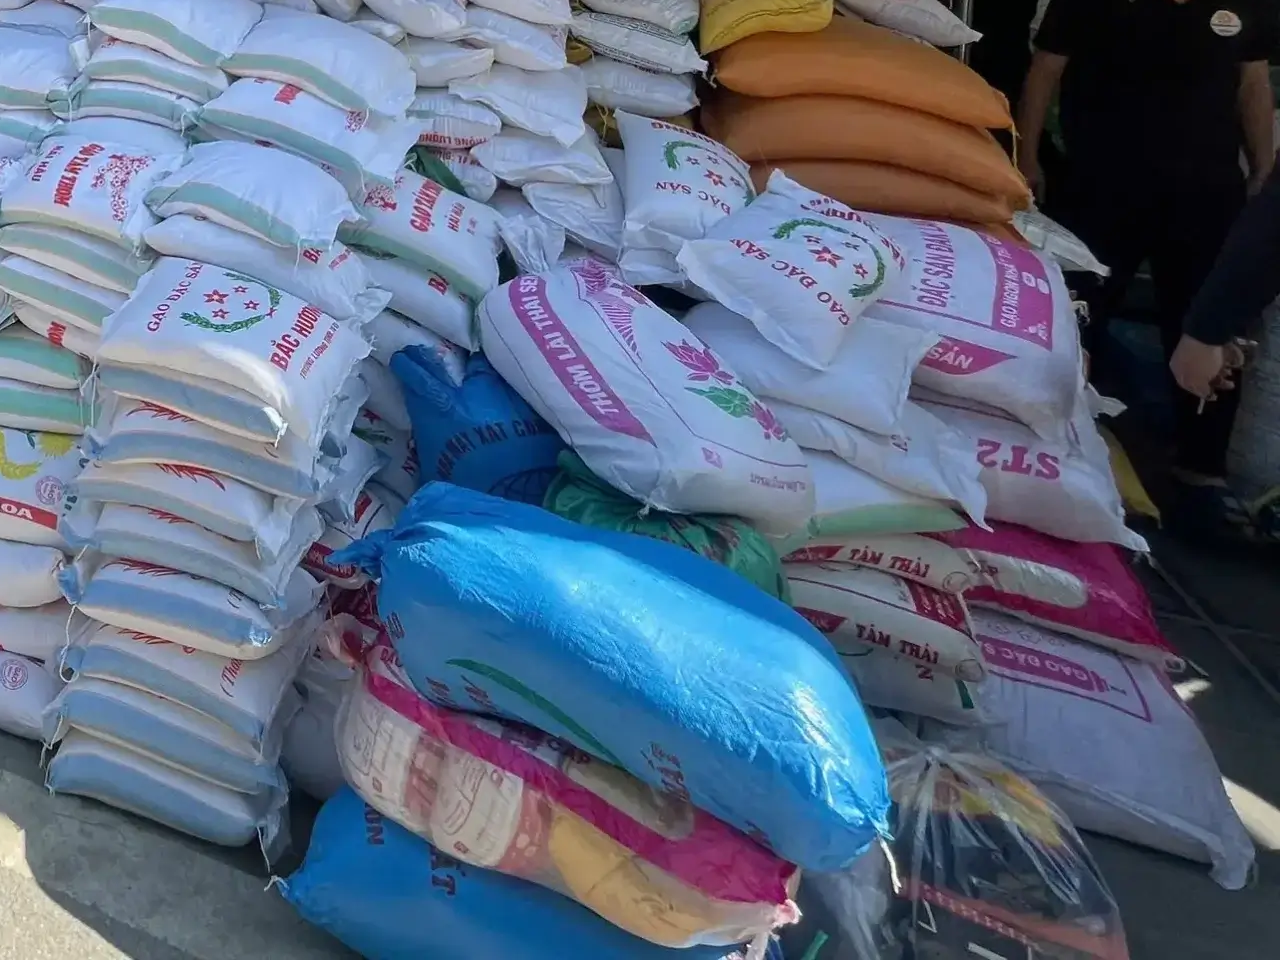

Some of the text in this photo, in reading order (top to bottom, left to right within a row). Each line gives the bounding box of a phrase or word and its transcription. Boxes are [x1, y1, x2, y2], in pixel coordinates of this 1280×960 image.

[771, 257, 818, 290] ĐẶC
[912, 250, 955, 280] SẢN
[147, 303, 170, 333] GẠO
[169, 278, 193, 302] ĐẶC
[816, 289, 850, 326] GẠO
[910, 276, 956, 307] ĐẶC
[519, 295, 554, 332] THÁI
[1000, 303, 1020, 328] GẠO
[270, 334, 302, 372] BẮC
[542, 331, 579, 362] LÀI
[565, 363, 621, 417] THƠM
